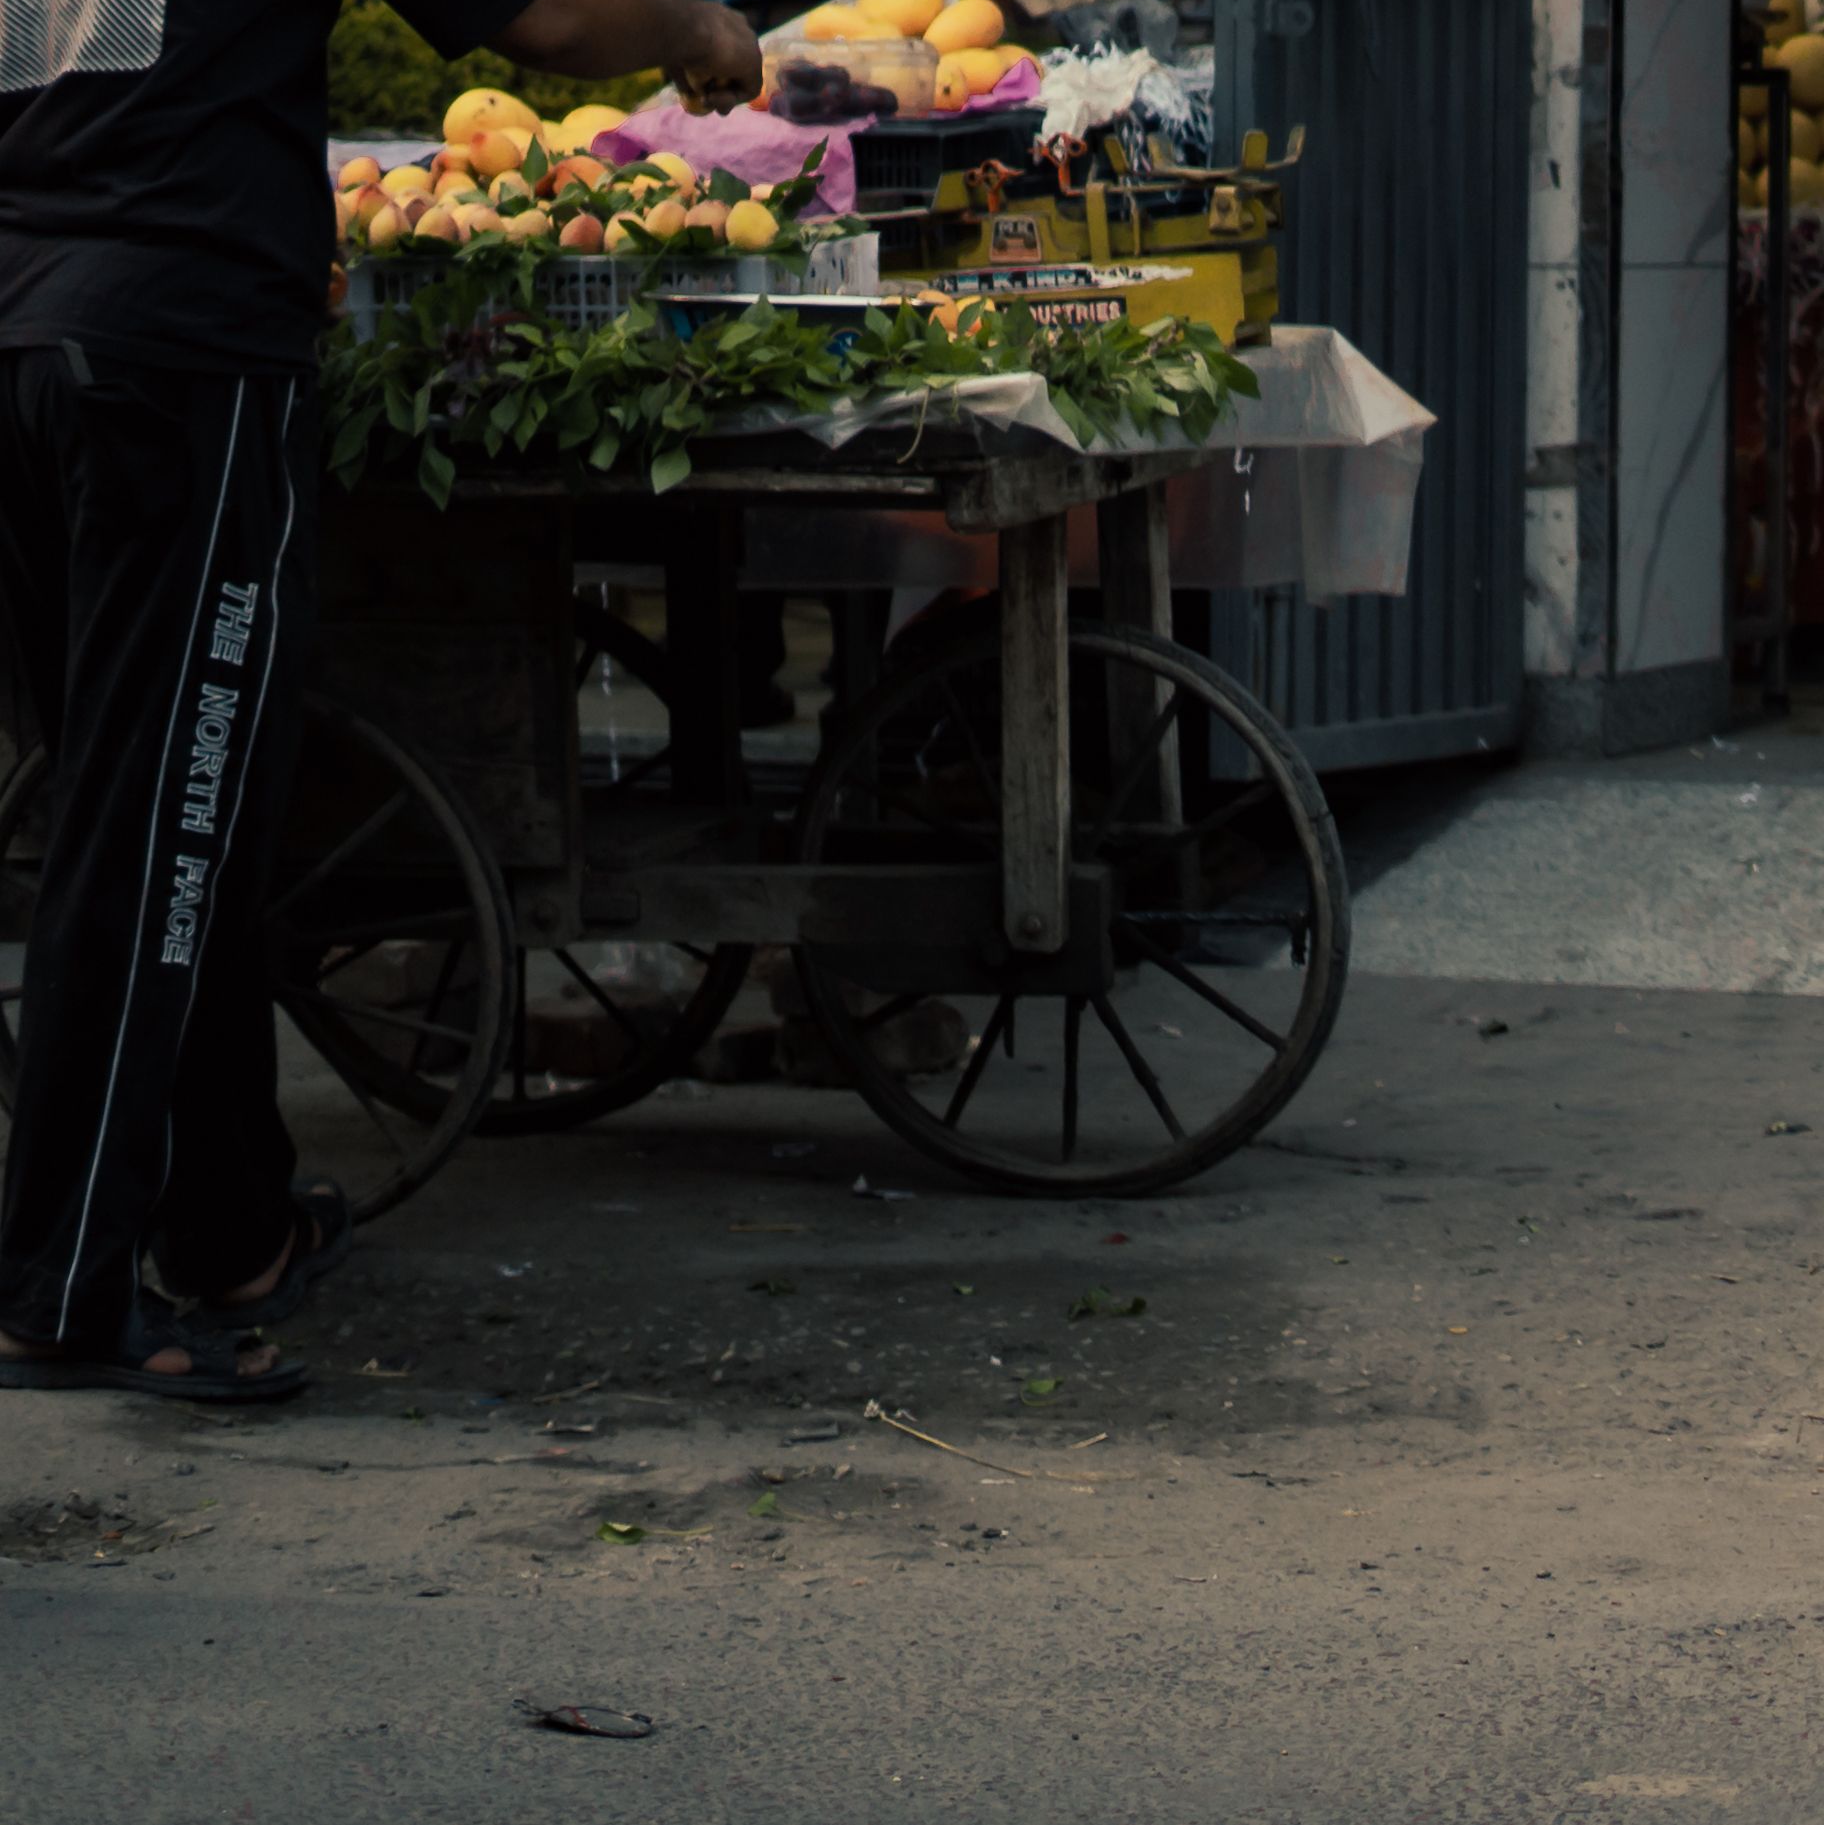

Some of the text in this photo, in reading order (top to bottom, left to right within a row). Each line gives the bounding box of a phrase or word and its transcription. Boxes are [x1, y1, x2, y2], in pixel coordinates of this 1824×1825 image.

[160, 581, 260, 966] THE NORTH FACE
